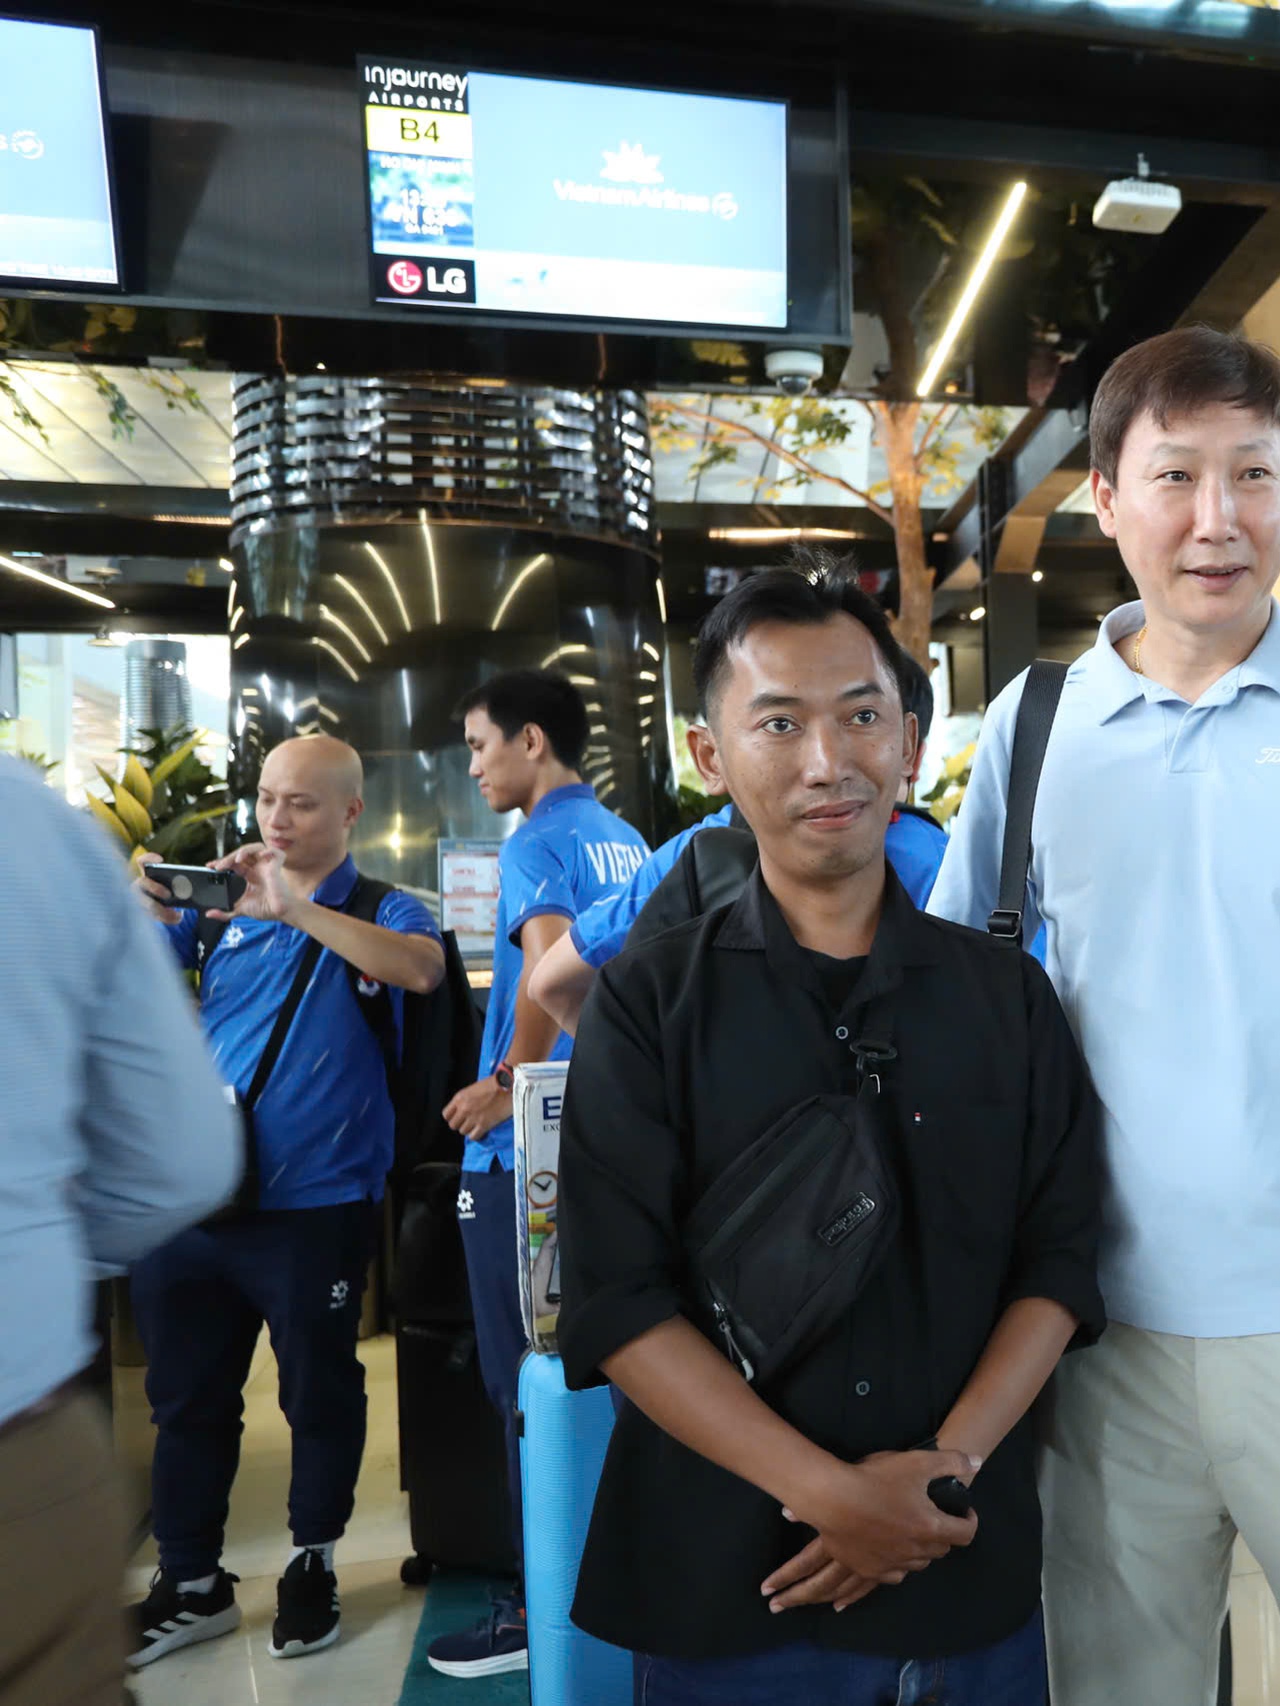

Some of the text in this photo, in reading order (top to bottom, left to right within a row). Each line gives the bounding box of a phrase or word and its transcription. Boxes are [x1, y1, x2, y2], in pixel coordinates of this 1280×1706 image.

[368, 90, 465, 112] AIRPORTS
[400, 117, 440, 142] B4
[427, 266, 467, 294] LG
